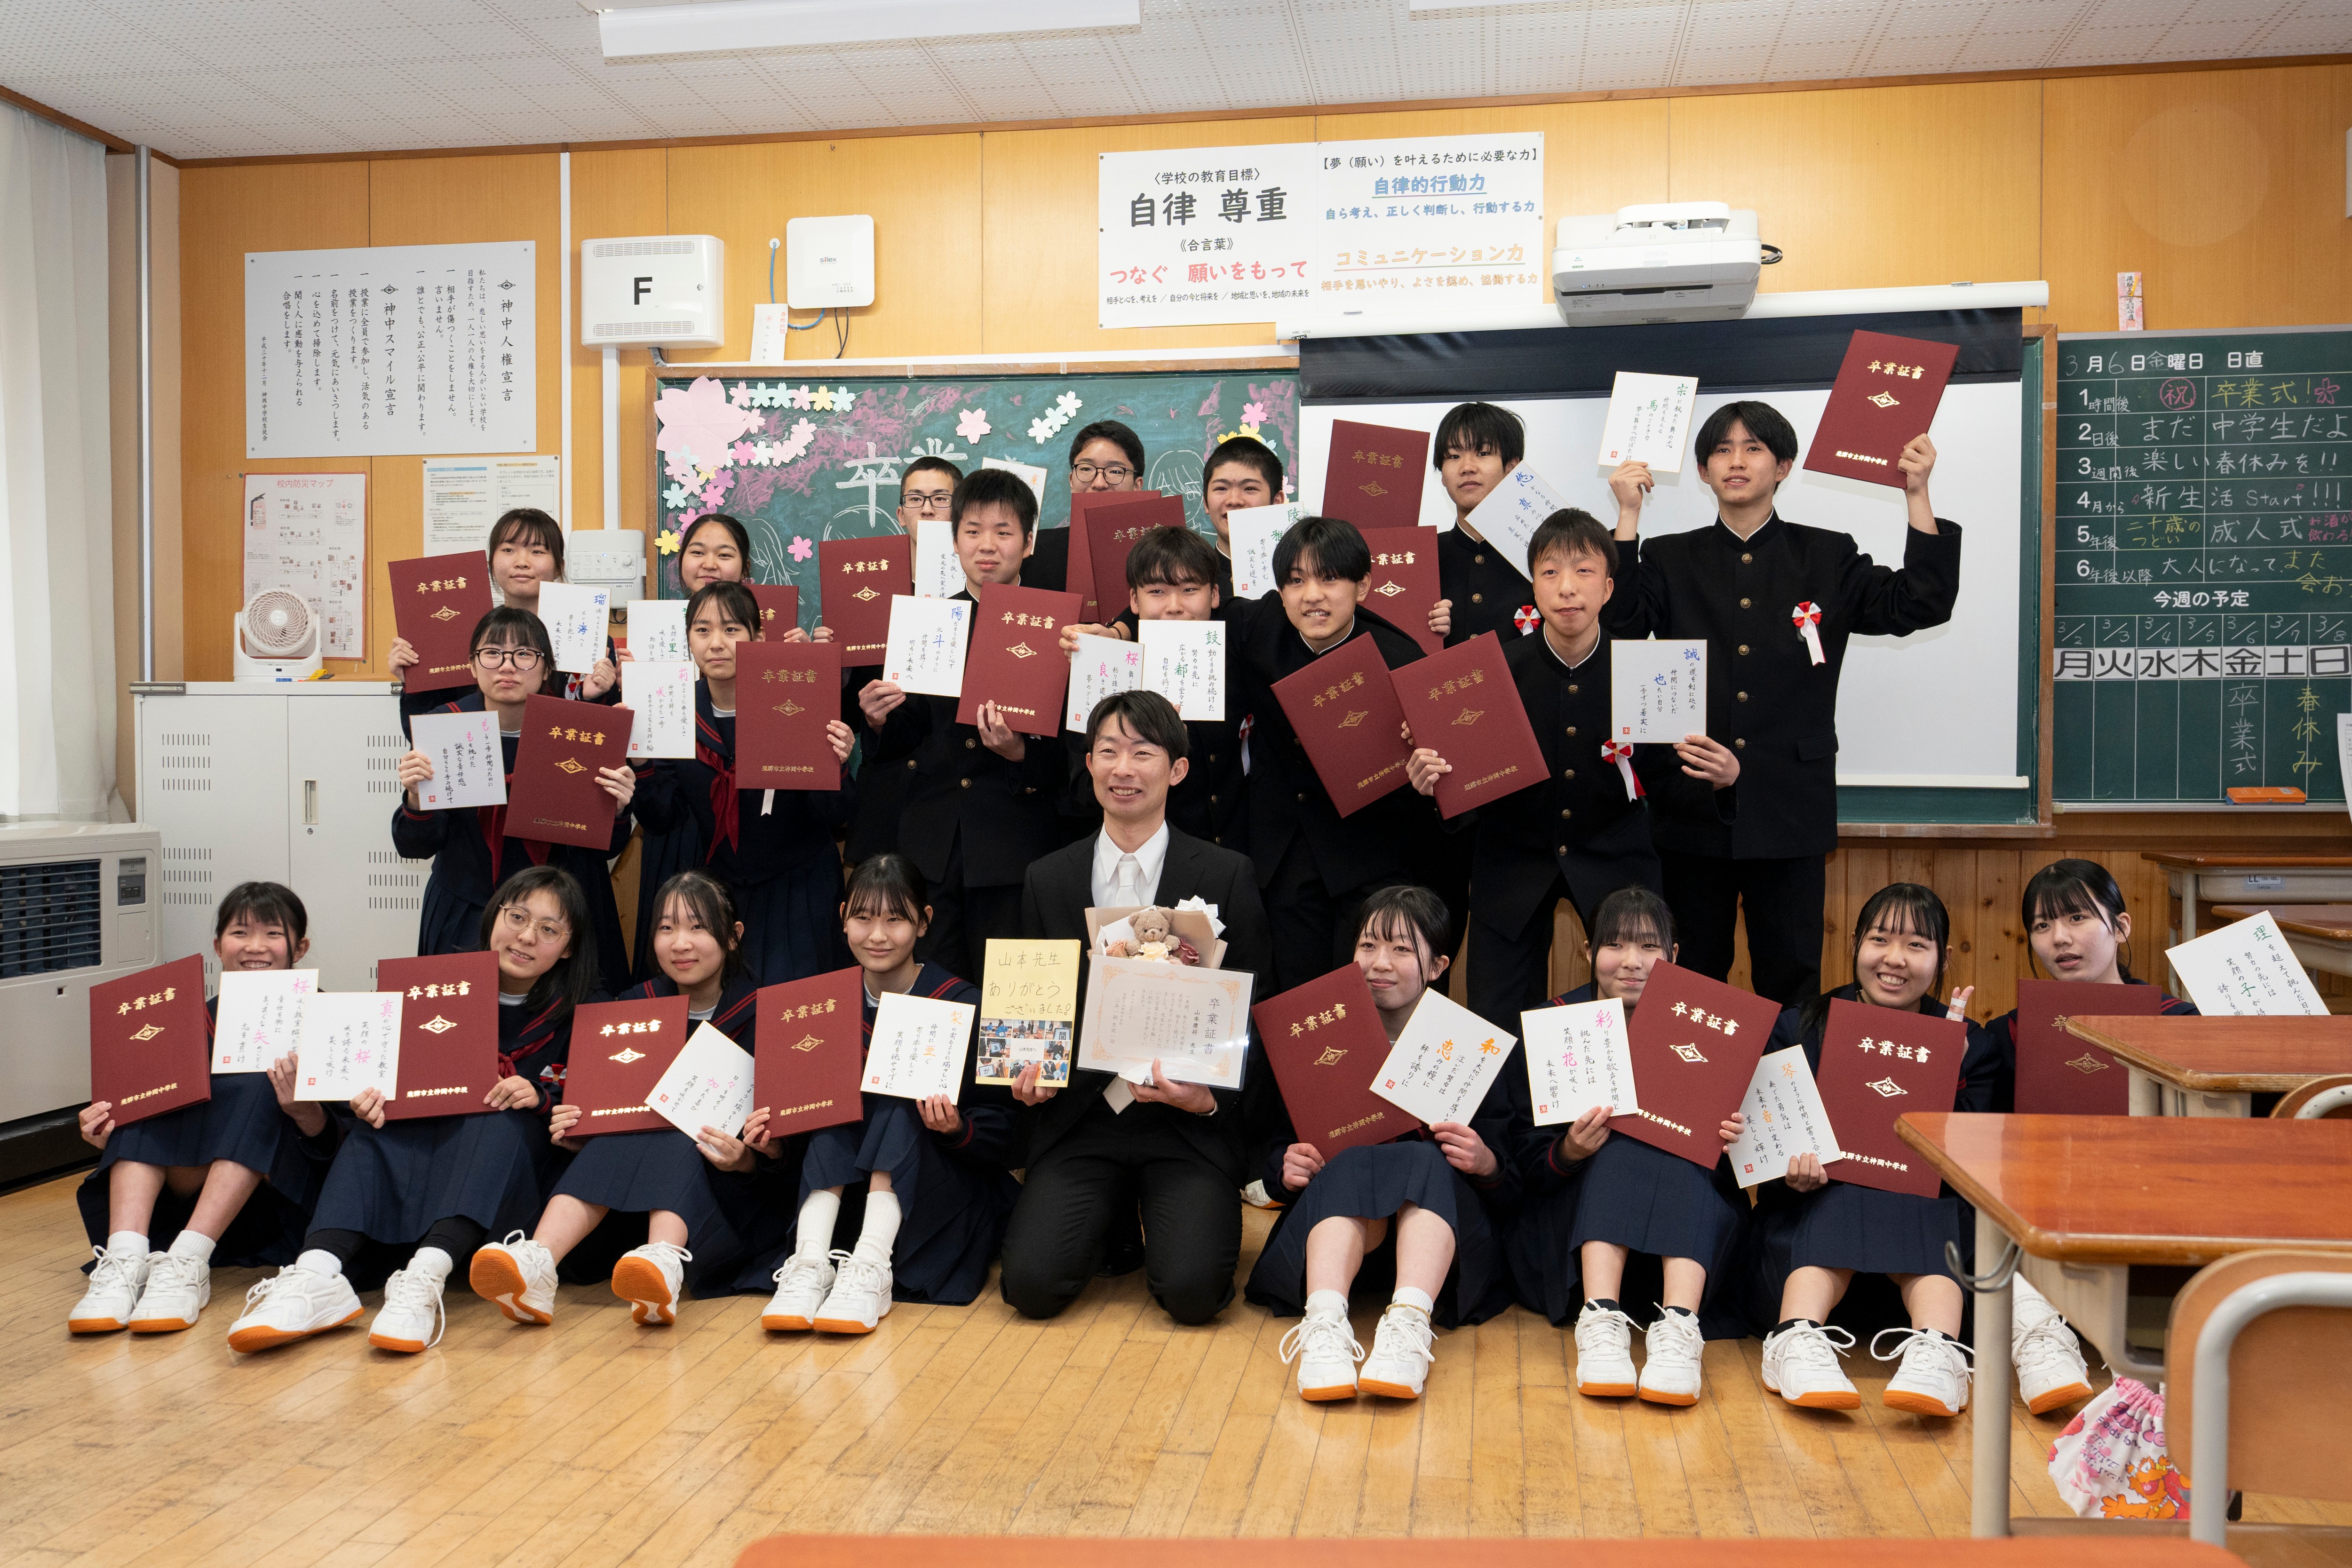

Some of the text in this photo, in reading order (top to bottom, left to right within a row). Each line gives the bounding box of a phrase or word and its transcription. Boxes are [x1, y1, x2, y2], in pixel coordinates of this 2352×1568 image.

[1153, 167, 1261, 184] 〈学校の教育目標〉
[1374, 174, 1487, 195] 自律的行動力
[1130, 186, 1288, 228] 自律 尊重
[1326, 200, 1535, 221] 自ら考え、正しく判断し、行動する力
[1110, 260, 1307, 285] つなぐ 願いをもって
[1336, 244, 1524, 267] コミュニケーション力
[634, 277, 652, 305] F
[1106, 289, 1310, 305] 相手と心を、考えを 自分の今と将来を 地域と思いを、地域の未来を
[1321, 273, 1538, 292] 相手を思いやり、よさを認め、協働する力
[283, 292, 292, 353] 合唱をします。
[348, 288, 358, 369] 授業をつくります。
[435, 285, 444, 339] 言いません。
[294, 291, 303, 407] 聞く人に感動を与えられる
[312, 291, 322, 390] 心を込めて掃除します。
[360, 288, 369, 430] 授業に全員で参加し、活気のある
[447, 285, 456, 417] 相手が傷つくことをしません。
[468, 269, 476, 427] 目指すため、一人一人の人権を大切にします。
[501, 299, 514, 402] 神中人権宣言
[2227, 351, 2263, 368] 日直
[330, 289, 341, 443] 名前をつけて、元気にあいさつします。
[383, 303, 396, 417] 神中スマイル宣言
[417, 286, 427, 437] 誰とでも、公正・公平に関わります。
[1867, 358, 1925, 381] 卒業証書
[2163, 385, 2189, 405] 祝
[1657, 396, 1670, 434] 仲間を支える
[2078, 423, 2121, 447] 2日後
[1352, 450, 1404, 468] 卒業証書
[2078, 458, 2139, 480] 3週間後
[277, 479, 333, 487] 校内防災マップ
[2077, 492, 2124, 514] 4月から
[2140, 484, 2233, 510] 新生活
[2077, 525, 2120, 549] 5年後
[2211, 516, 2303, 543] 成人式
[842, 559, 890, 574] 卒業証書
[1247, 548, 1257, 587] 誠実な道を
[1370, 551, 1416, 566] 業証書
[2077, 560, 2153, 586] 6年後以降
[416, 577, 467, 595] 卒業証書
[2153, 590, 2249, 607] 今週の予定
[948, 606, 963, 669] 陽だまりの優しい心で
[1001, 612, 1056, 629] 卒業証書
[668, 624, 678, 659] 笑顔の里に
[906, 640, 916, 680] 明るい未来へ
[920, 633, 928, 669] 仲間を導く
[932, 627, 944, 673] 北斗のように
[762, 670, 818, 683] 卒業証書
[1174, 644, 1188, 707] 広がる都を堂々と
[1205, 630, 1222, 712] 鼓動くまま挑み続けた
[1684, 648, 1700, 710] 誠の道を剣に込め
[2055, 645, 2349, 677] 月 火 水 木 金 土 日
[1313, 671, 1364, 707] 卒業証書
[1428, 669, 1484, 701] 卒業証書
[548, 726, 606, 745] 卒業証書
[2227, 683, 2259, 774] 卒業式
[2291, 685, 2322, 774] 春休み
[454, 742, 466, 786] 誠実な責任感
[999, 951, 1061, 967] 山本先生
[2244, 952, 2277, 997] 努力の先には
[117, 987, 176, 1016] 卒業証書
[407, 980, 471, 1000] 卒業証書
[989, 981, 1060, 997] ありがとう
[600, 1019, 662, 1036] 卒業証書
[780, 999, 837, 1023] 卒業証書
[1204, 998, 1220, 1055] 卒業証書
[1290, 1003, 1346, 1038] 卒業証書
[1671, 1001, 1740, 1036] 卒業証書
[237, 1022, 249, 1063] 志を貫け
[326, 1036, 336, 1077] 美しく咲け
[340, 1025, 353, 1081] 咲き誇る未来へ
[354, 1021, 371, 1064] 笑顔の桜
[378, 999, 394, 1078] 真の心で守った教室
[1189, 1043, 1196, 1055] 先生
[1580, 1030, 1596, 1084] 挑んだ先には
[1858, 1037, 1931, 1063] 卒業証書
[885, 1031, 903, 1089] 笑顔を絶やさずに
[1401, 1044, 1429, 1088] 絆を誇りに
[1423, 1039, 1454, 1088] 恵みの糧に
[1439, 1055, 1465, 1095] 注いだ努力は
[1562, 1027, 1578, 1093] 笑顔の花が咲く
[1596, 1010, 1619, 1110] 彩り豊かな歌声を仲間と
[1547, 1060, 1559, 1109] 未来へ響け
[1756, 1088, 1784, 1156] 未来の音に変わる
[1769, 1081, 1791, 1130] 奏でた勇気は
[1746, 1114, 1768, 1163] 美しく輝け
